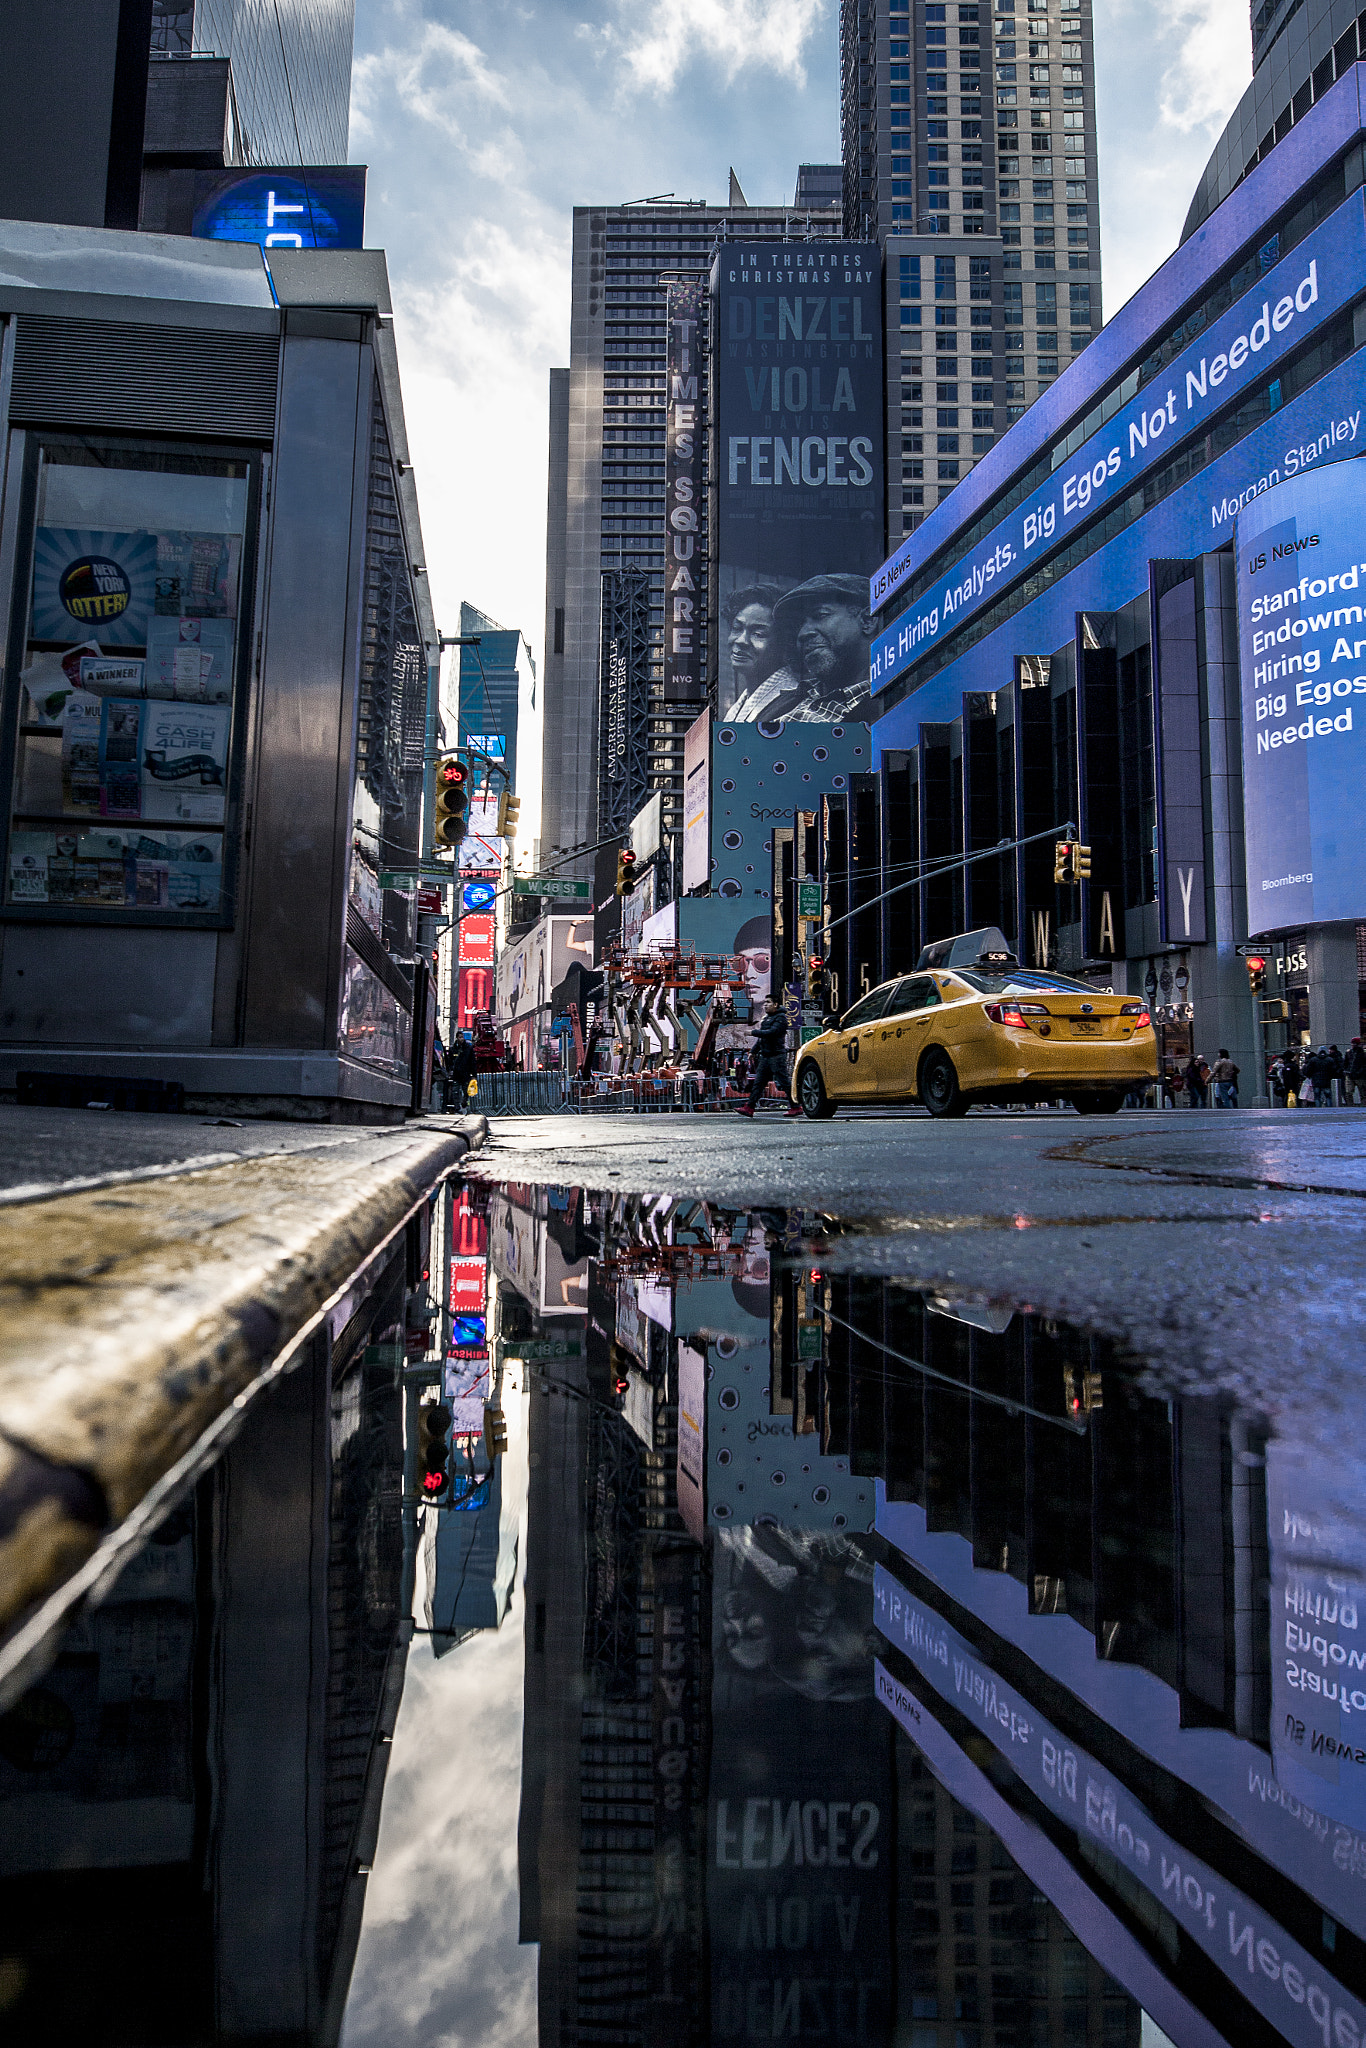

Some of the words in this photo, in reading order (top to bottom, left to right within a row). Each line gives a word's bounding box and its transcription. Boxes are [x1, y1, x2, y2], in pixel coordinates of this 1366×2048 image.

[729, 271, 831, 283] CHRISTMAS
[845, 271, 873, 283] DAY
[740, 254, 757, 266] IN
[772, 254, 862, 267] THEATRES
[728, 296, 873, 341] DENZEL
[729, 343, 873, 359] WASHINGTON
[671, 319, 698, 459] TIMES
[744, 366, 856, 412] VIOLA
[764, 415, 829, 430] DAVIS
[728, 435, 874, 486] FENCES
[884, 644, 895, 670] Is
[898, 606, 939, 658] Hiring
[942, 542, 1017, 620] Analysts.
[1023, 502, 1055, 550] Big
[1062, 446, 1121, 516] Egos
[1128, 389, 1178, 459] Not
[1185, 258, 1319, 410] Needed
[1211, 469, 1280, 528] Morgan
[1284, 410, 1361, 477] Stanley
[93, 563, 118, 577] NEW
[670, 476, 699, 654] SQUARE
[1249, 552, 1267, 575] US
[1271, 533, 1321, 563] News
[96, 577, 126, 593] YORK
[874, 577, 887, 600] US
[887, 553, 912, 587] News
[66, 593, 129, 618] LOTTERY
[1252, 605, 1366, 656] Endowm
[87, 672, 95, 681] A
[95, 668, 138, 681] WINNER!
[609, 638, 619, 688] EAGLE
[672, 675, 693, 684] NYC
[1254, 649, 1321, 689] Hiring
[616, 656, 627, 756] OUTFITTERS
[1256, 693, 1287, 722] Big
[154, 738, 213, 751] 4LIFE
[156, 726, 216, 740] CASH
[607, 692, 618, 779] AMERICAN
[1256, 707, 1353, 755] Needed
[527, 881, 538, 892] W
[542, 883, 560, 893] 48
[563, 883, 577, 894] St
[1262, 872, 1314, 891] Bloomberg
[988, 952, 1008, 961] 5C96
